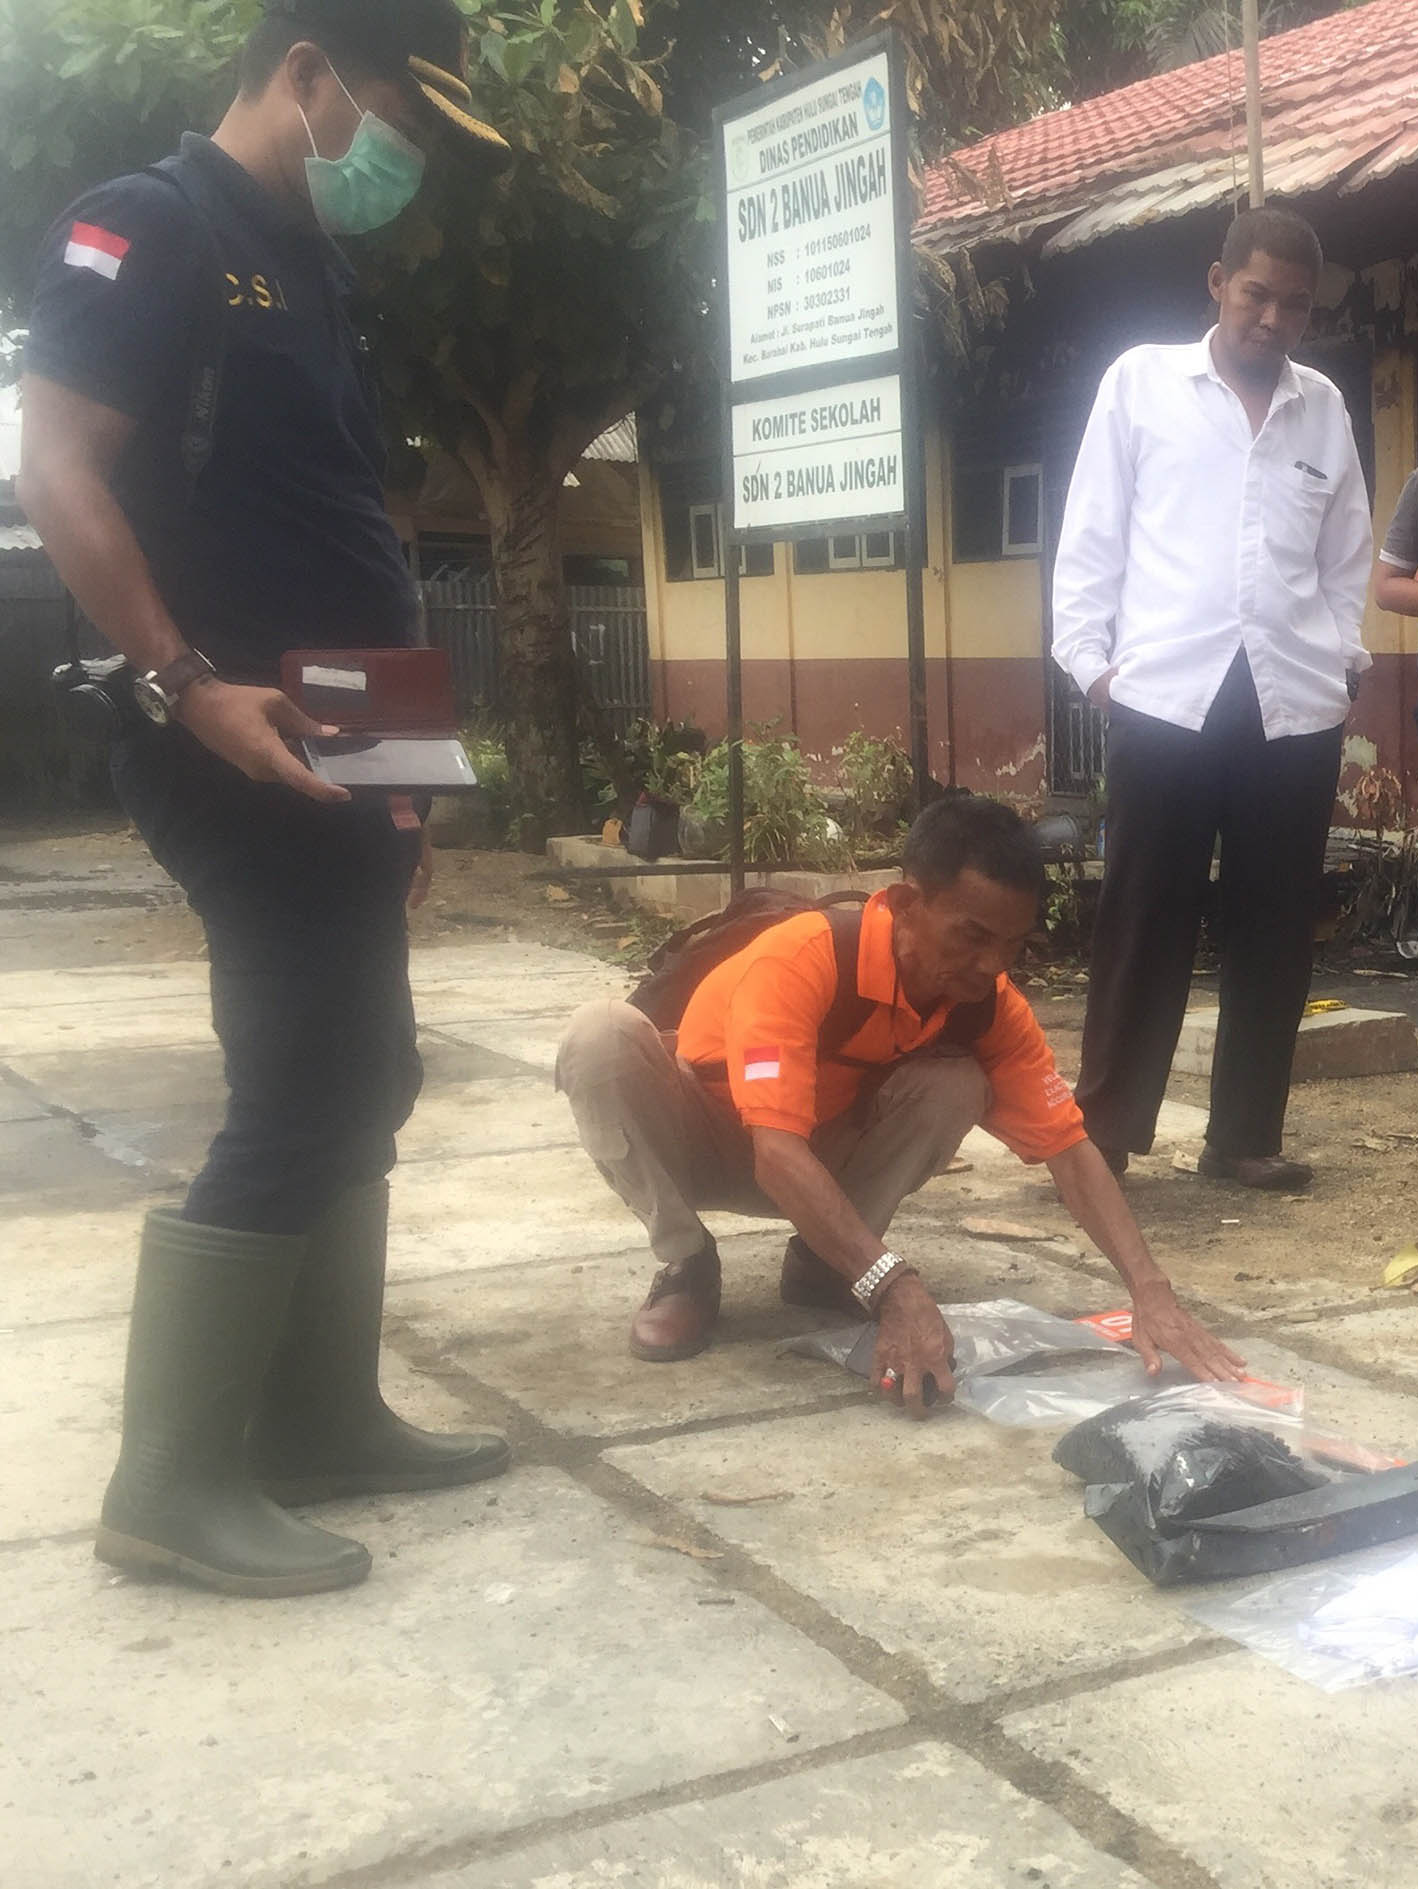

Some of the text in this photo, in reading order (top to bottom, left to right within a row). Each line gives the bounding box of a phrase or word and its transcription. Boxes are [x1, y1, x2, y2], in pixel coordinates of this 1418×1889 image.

[760, 111, 859, 174] DINAS PENDIDIKAN
[738, 147, 886, 243] SDN 2 BANUA JINGAH
[805, 258, 851, 284] 10601024
[767, 300, 791, 320] NPSN
[803, 285, 851, 312] 30302331
[858, 305, 885, 320] Jingah
[831, 330, 861, 345] Sungai
[864, 323, 893, 339] Tengah
[752, 397, 881, 441] KOMITE SEKOLAH
[743, 455, 897, 503] SDN 2 BANUA JINGAH
